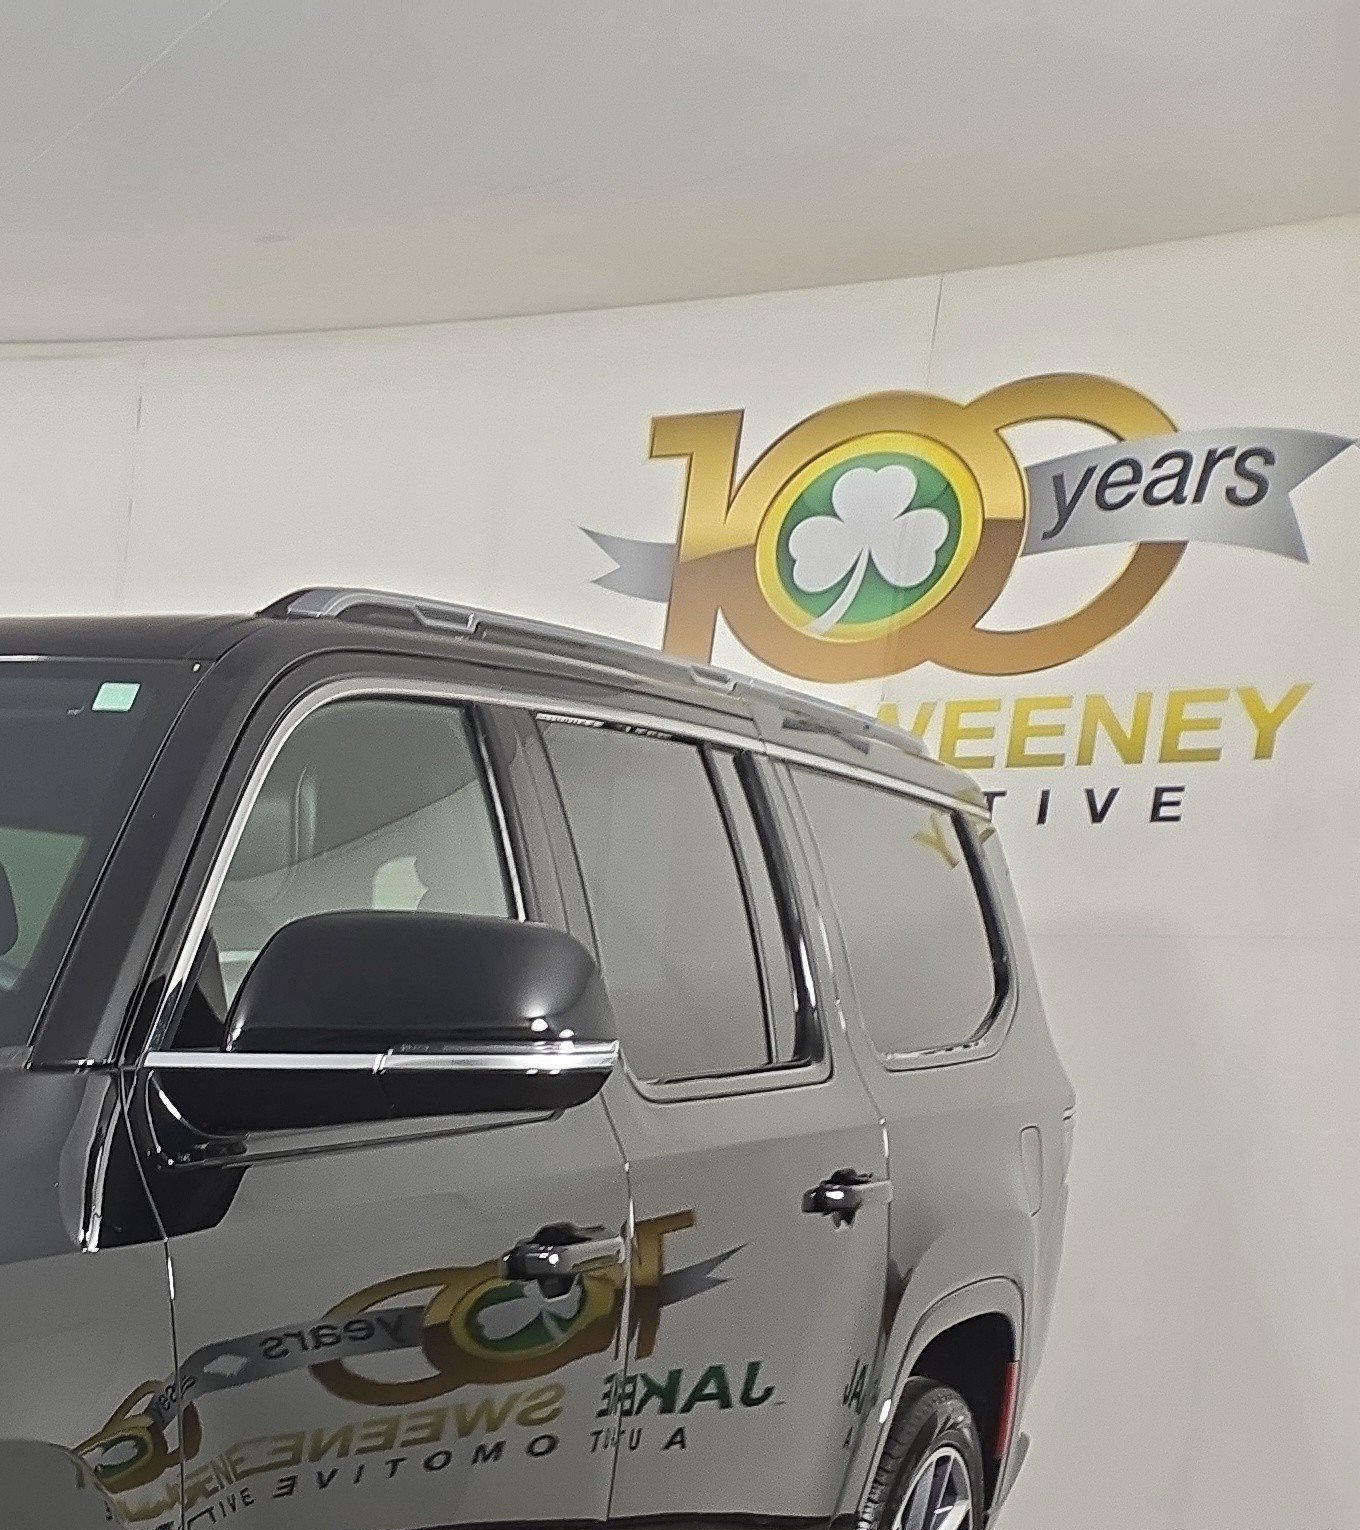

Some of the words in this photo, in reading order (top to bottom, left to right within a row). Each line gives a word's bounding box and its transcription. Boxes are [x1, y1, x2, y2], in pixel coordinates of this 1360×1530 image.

[648, 371, 1188, 684] 100
[1041, 444, 1277, 541] years
[848, 682, 1314, 770] WEENEY
[981, 785, 1187, 826] TIVE
